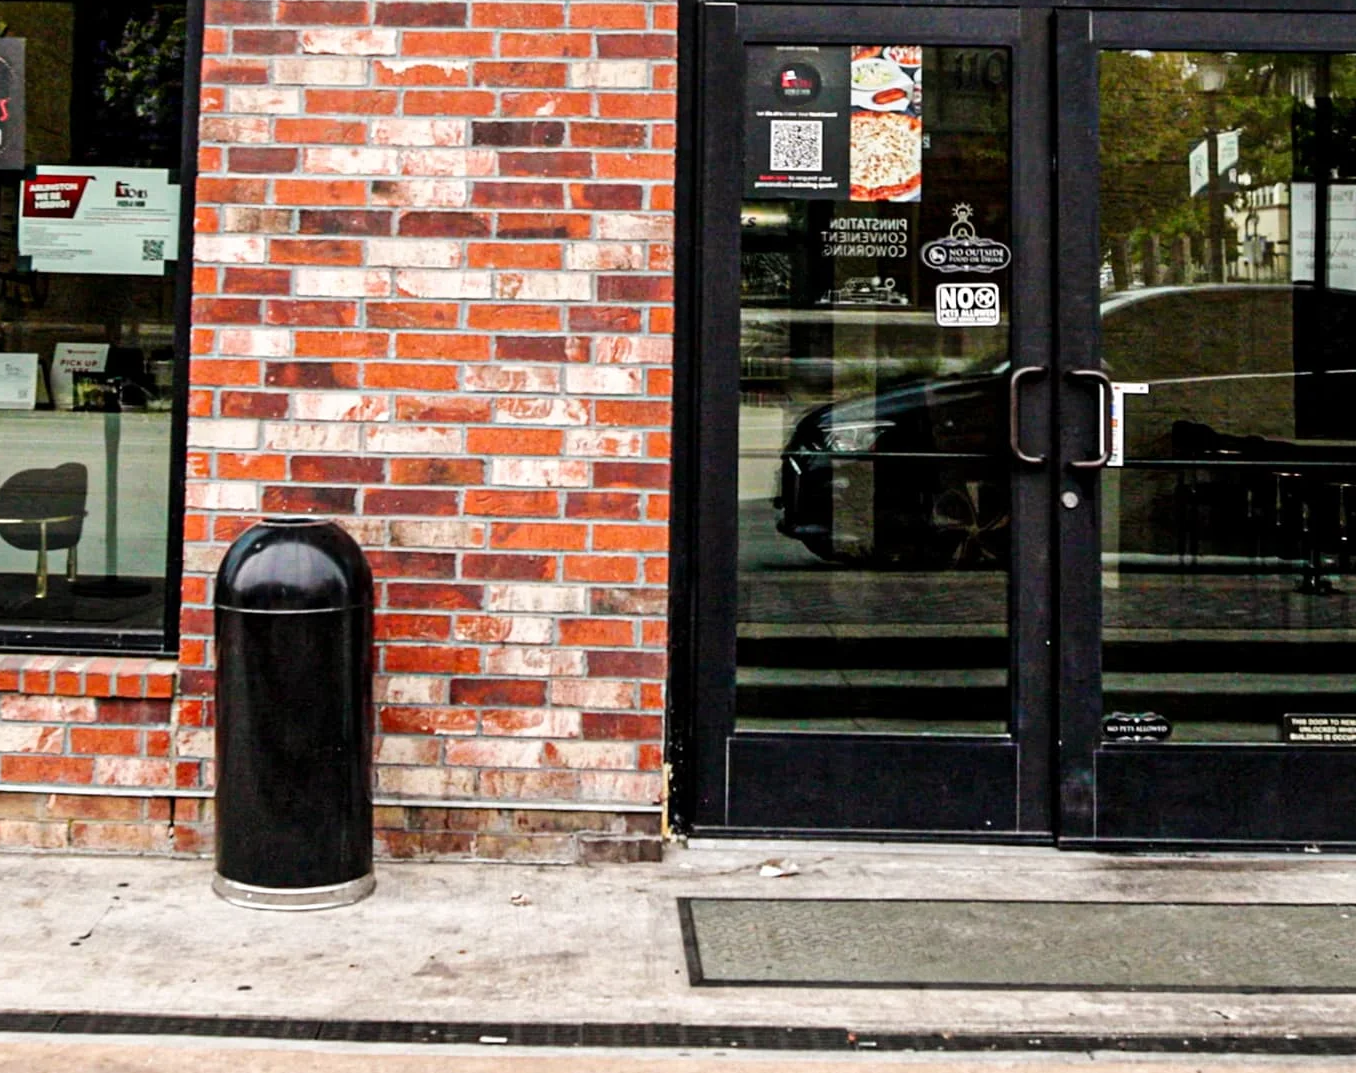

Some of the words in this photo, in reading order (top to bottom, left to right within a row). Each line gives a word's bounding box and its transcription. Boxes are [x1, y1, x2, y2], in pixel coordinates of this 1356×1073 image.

[949, 248, 964, 256] NO
[965, 248, 1004, 257] OUTSIDE
[940, 287, 974, 309] NO
